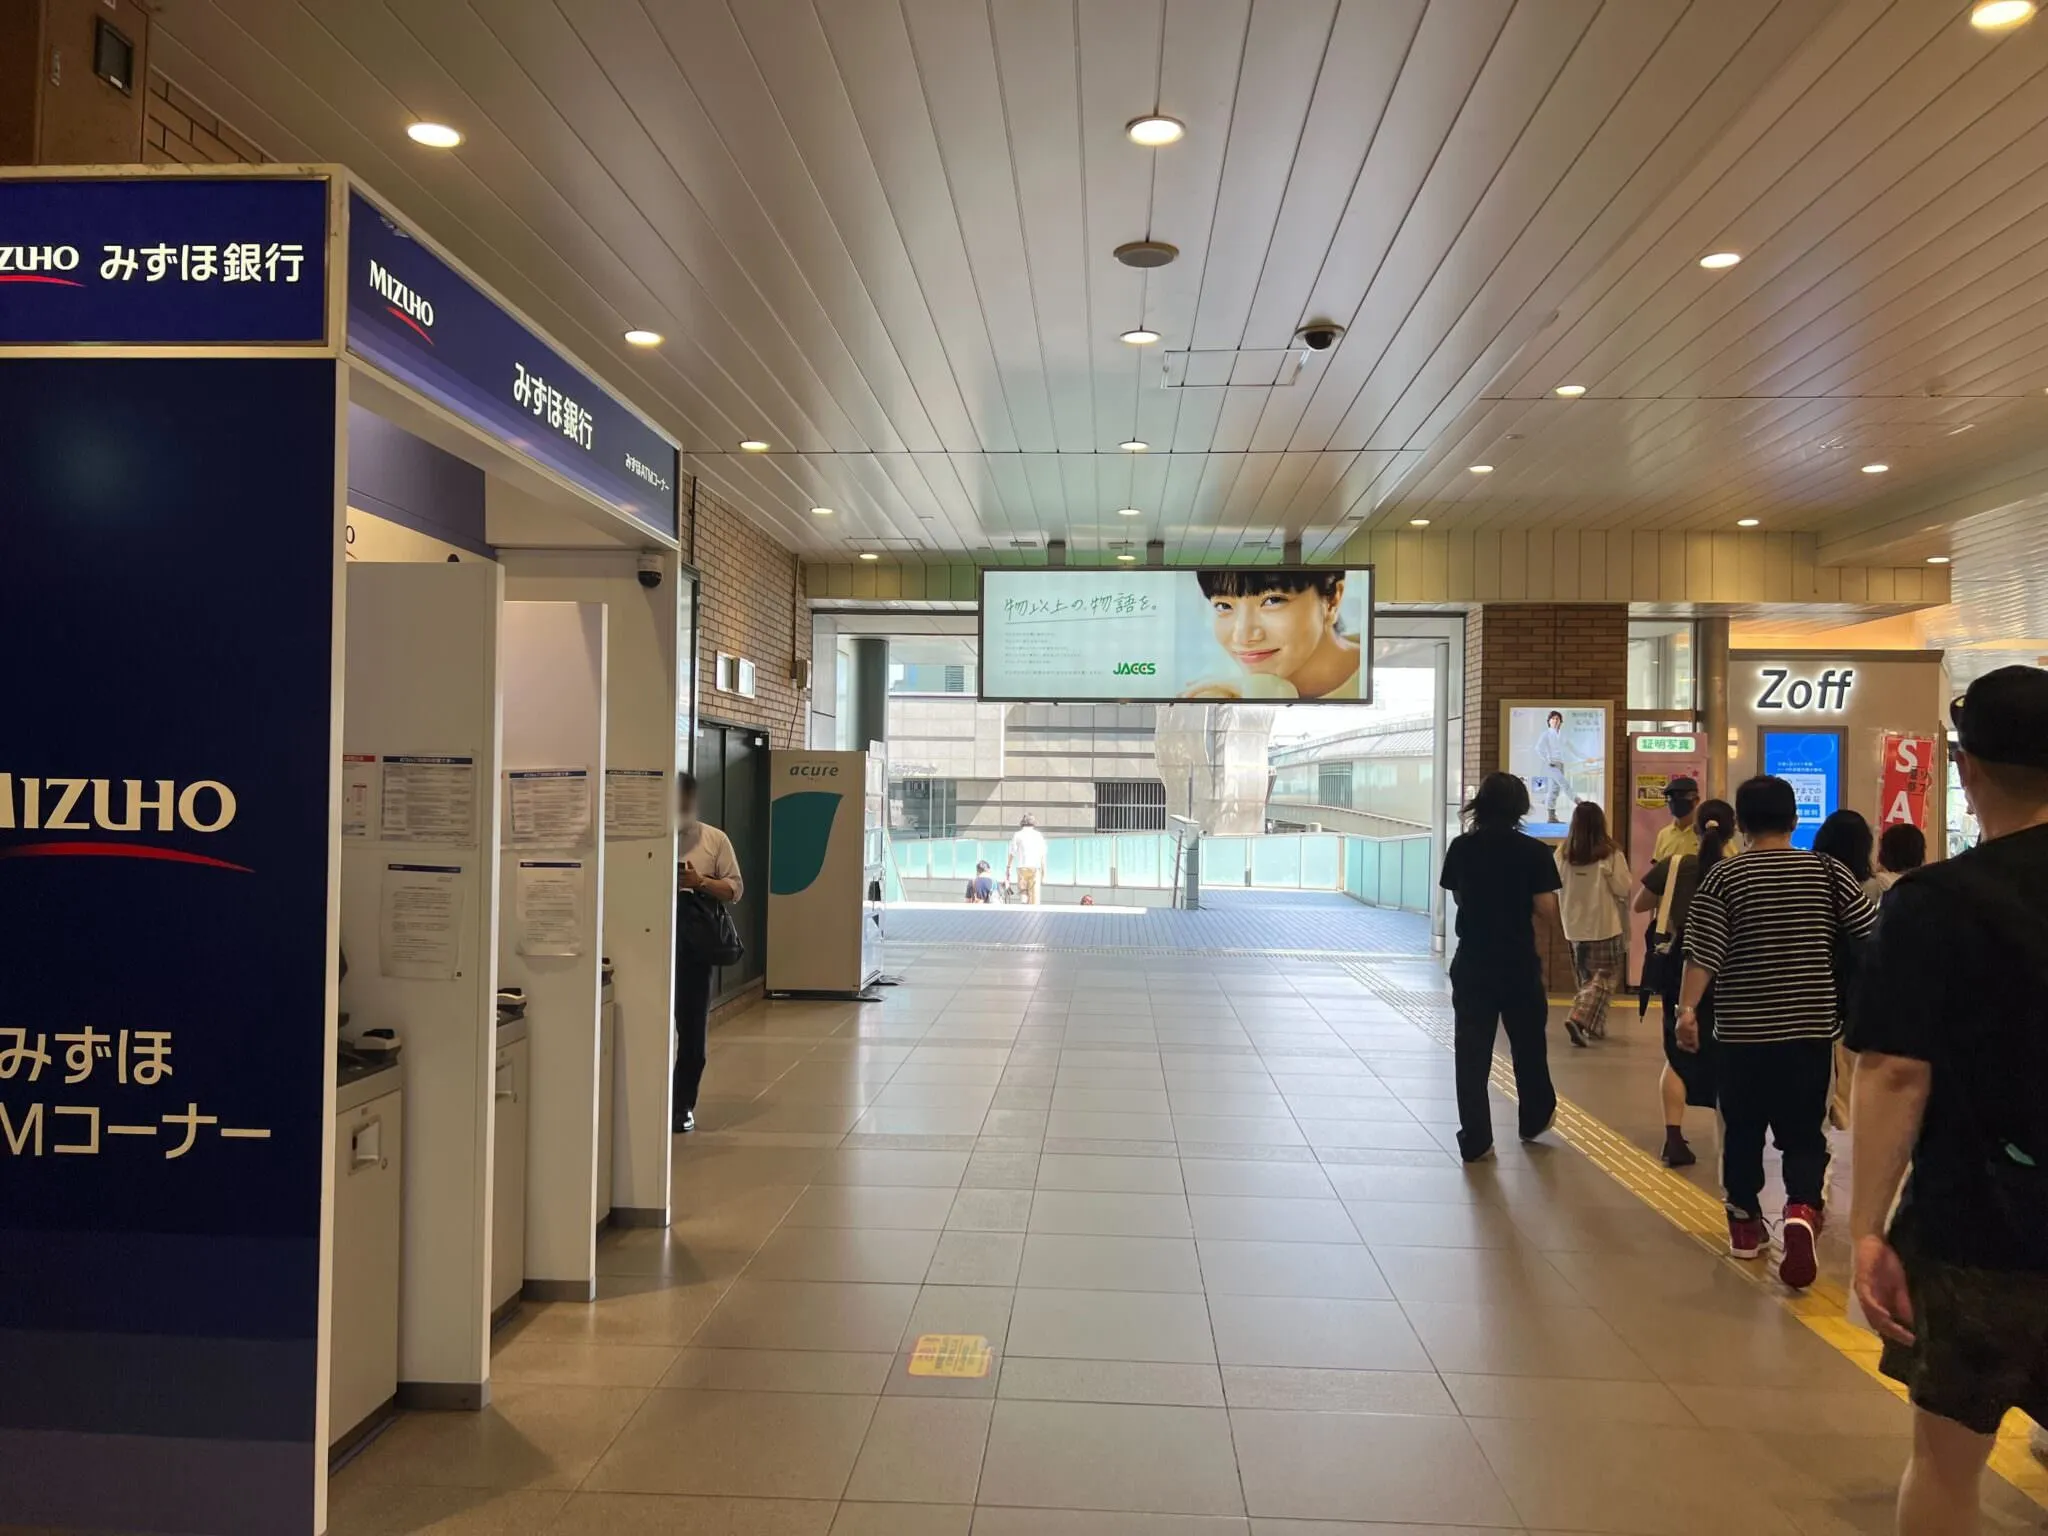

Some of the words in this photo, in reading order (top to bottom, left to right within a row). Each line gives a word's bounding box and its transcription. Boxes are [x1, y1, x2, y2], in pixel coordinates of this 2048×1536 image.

[100, 243, 304, 282] みずほ銀行
[369, 259, 434, 327] MIZUHO
[514, 362, 593, 450] みずほ銀行
[625, 453, 670, 491] みずほATMコーナー
[1113, 662, 1156, 675] JACCS
[1757, 669, 1853, 709] Zoff
[789, 765, 840, 777] acure
[0, 1026, 173, 1085] みずほ
